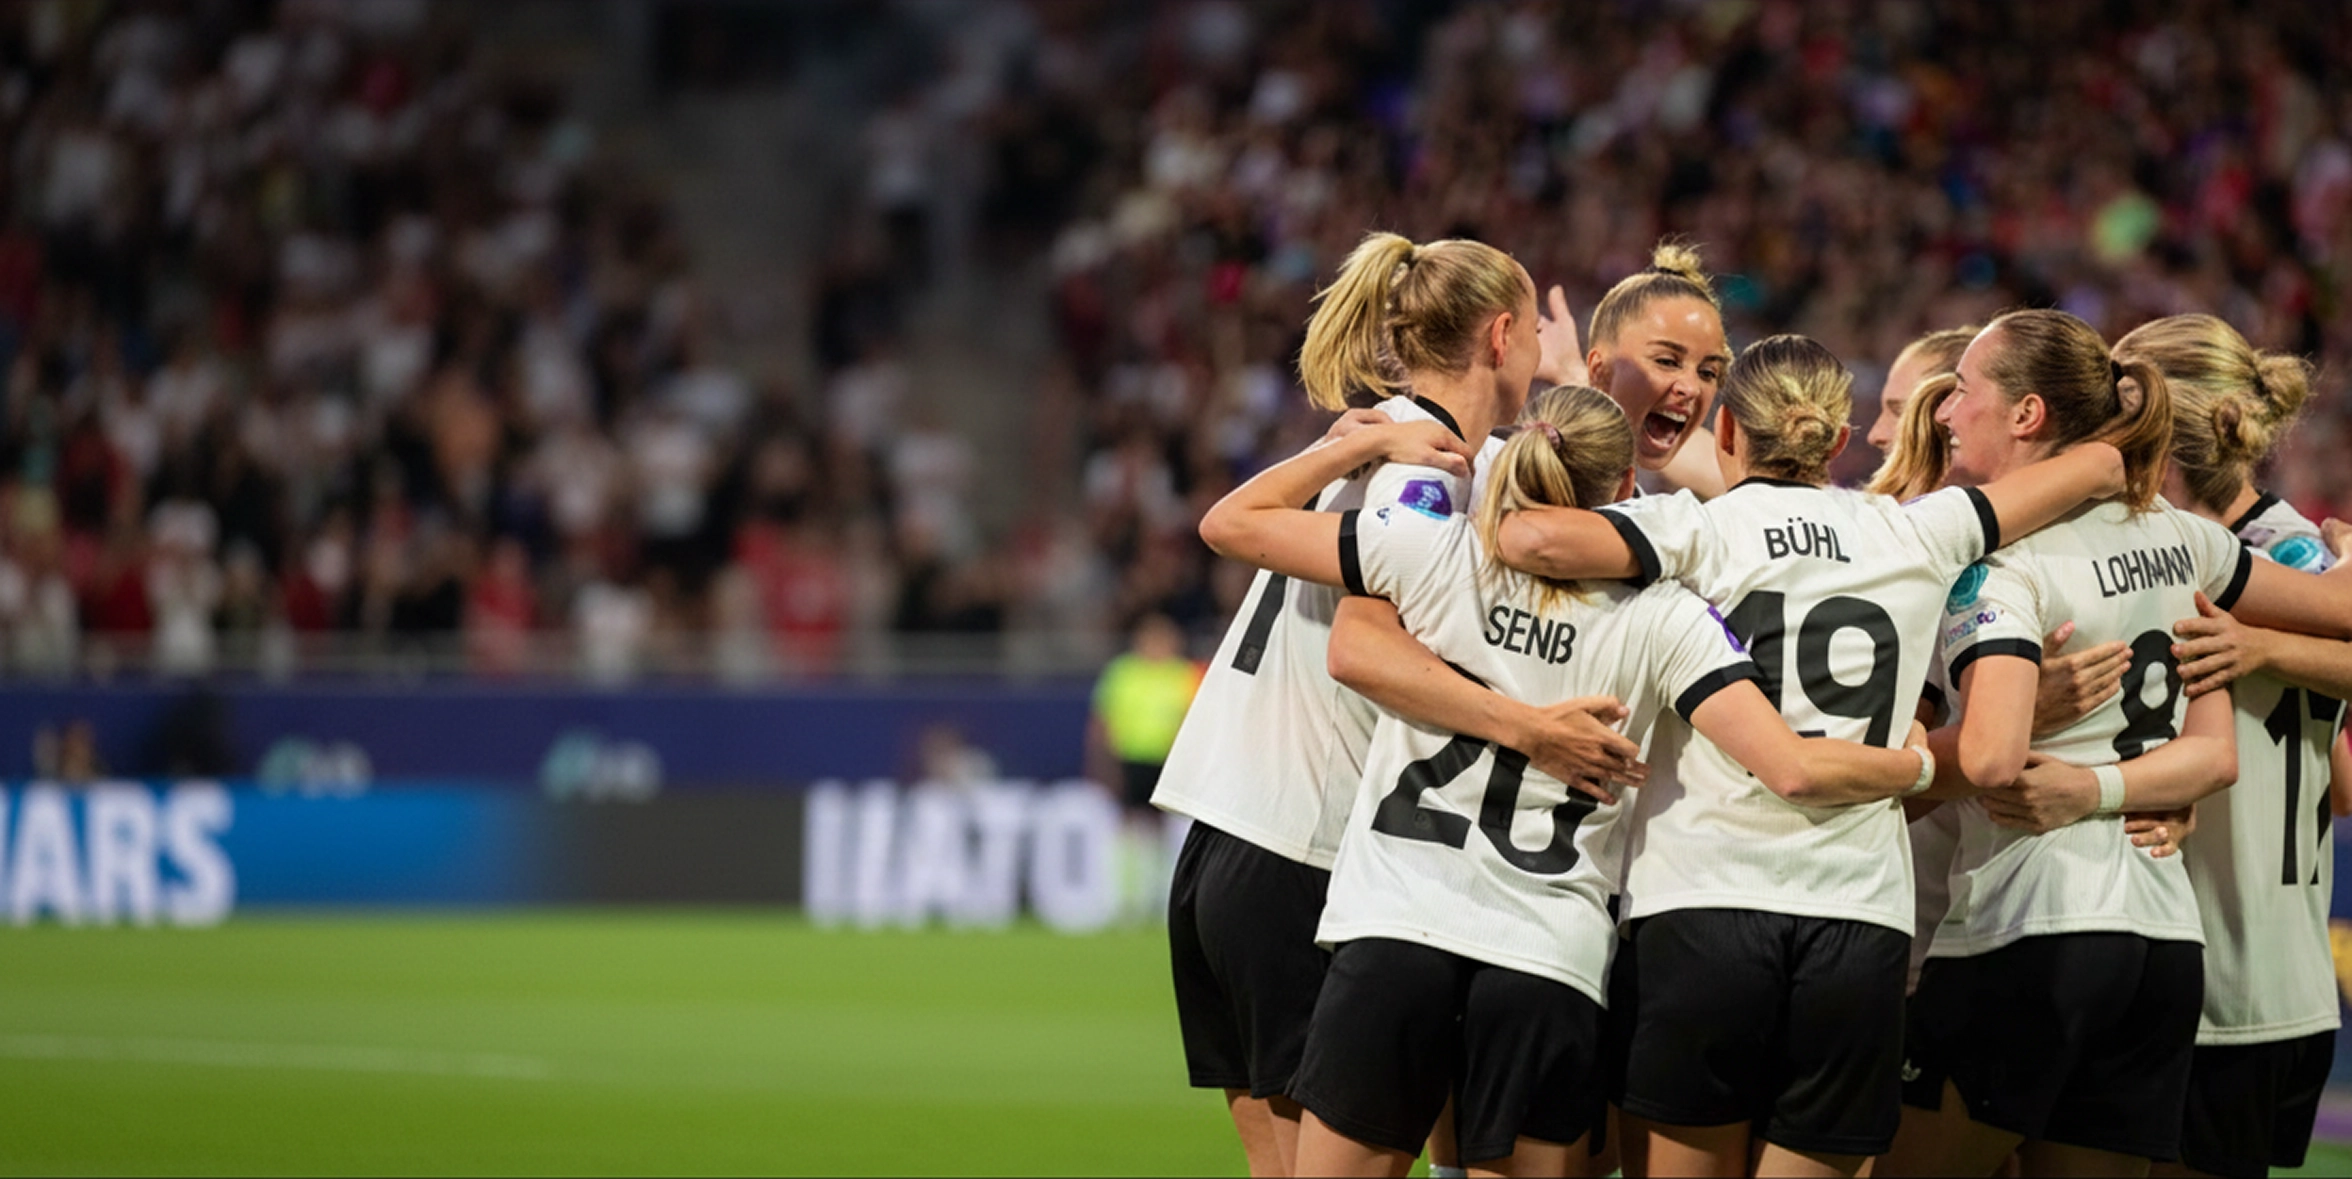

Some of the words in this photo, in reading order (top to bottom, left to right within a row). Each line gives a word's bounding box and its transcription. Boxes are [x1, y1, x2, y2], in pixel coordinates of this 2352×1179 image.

[1764, 517, 1850, 563] BÜHL
[1724, 590, 1900, 748] 19
[2112, 629, 2184, 761] 8
[1371, 661, 1600, 875] 20
